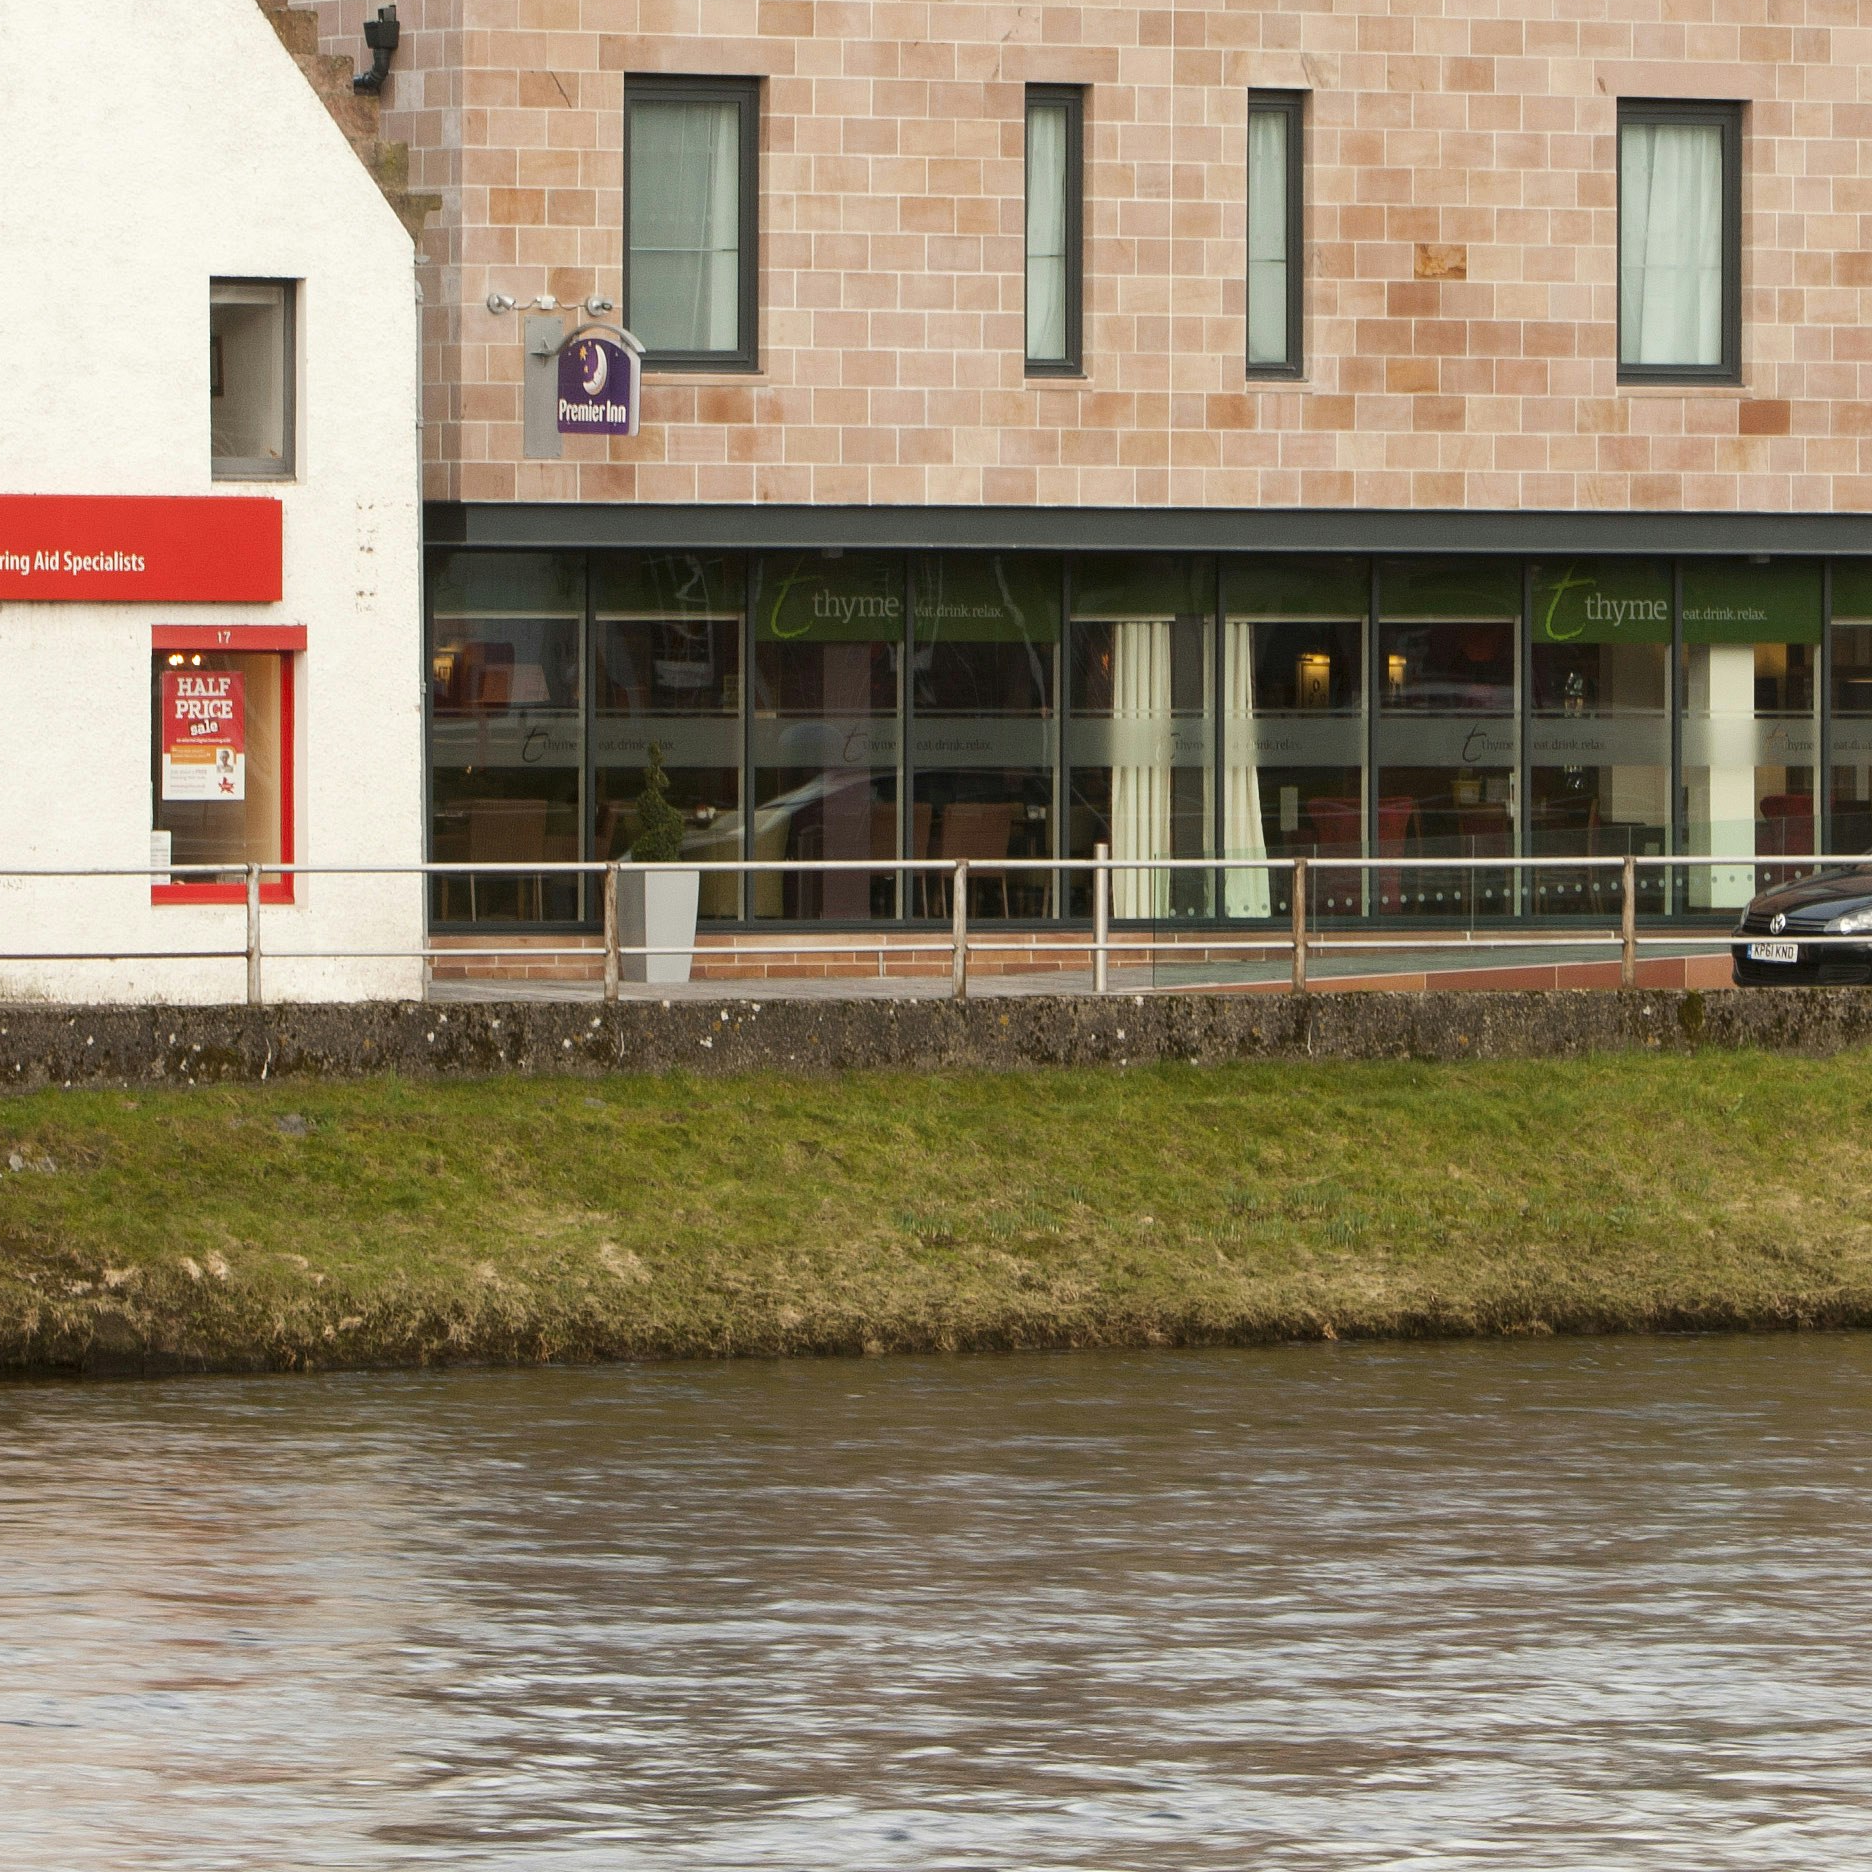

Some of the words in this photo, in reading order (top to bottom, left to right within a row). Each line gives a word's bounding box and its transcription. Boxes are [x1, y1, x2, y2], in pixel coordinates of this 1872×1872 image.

[559, 399, 605, 422] Premier
[606, 399, 626, 423] Inn
[34, 550, 59, 570] Aid
[64, 550, 145, 575] Specialists
[812, 589, 900, 624] thyme
[1585, 593, 1668, 626] thyme
[217, 631, 231, 644] 17
[177, 678, 231, 697] HALF
[175, 700, 233, 719] PRICE
[190, 720, 219, 736] sale
[1754, 943, 1773, 958] KP61
[1776, 945, 1794, 959] KND
